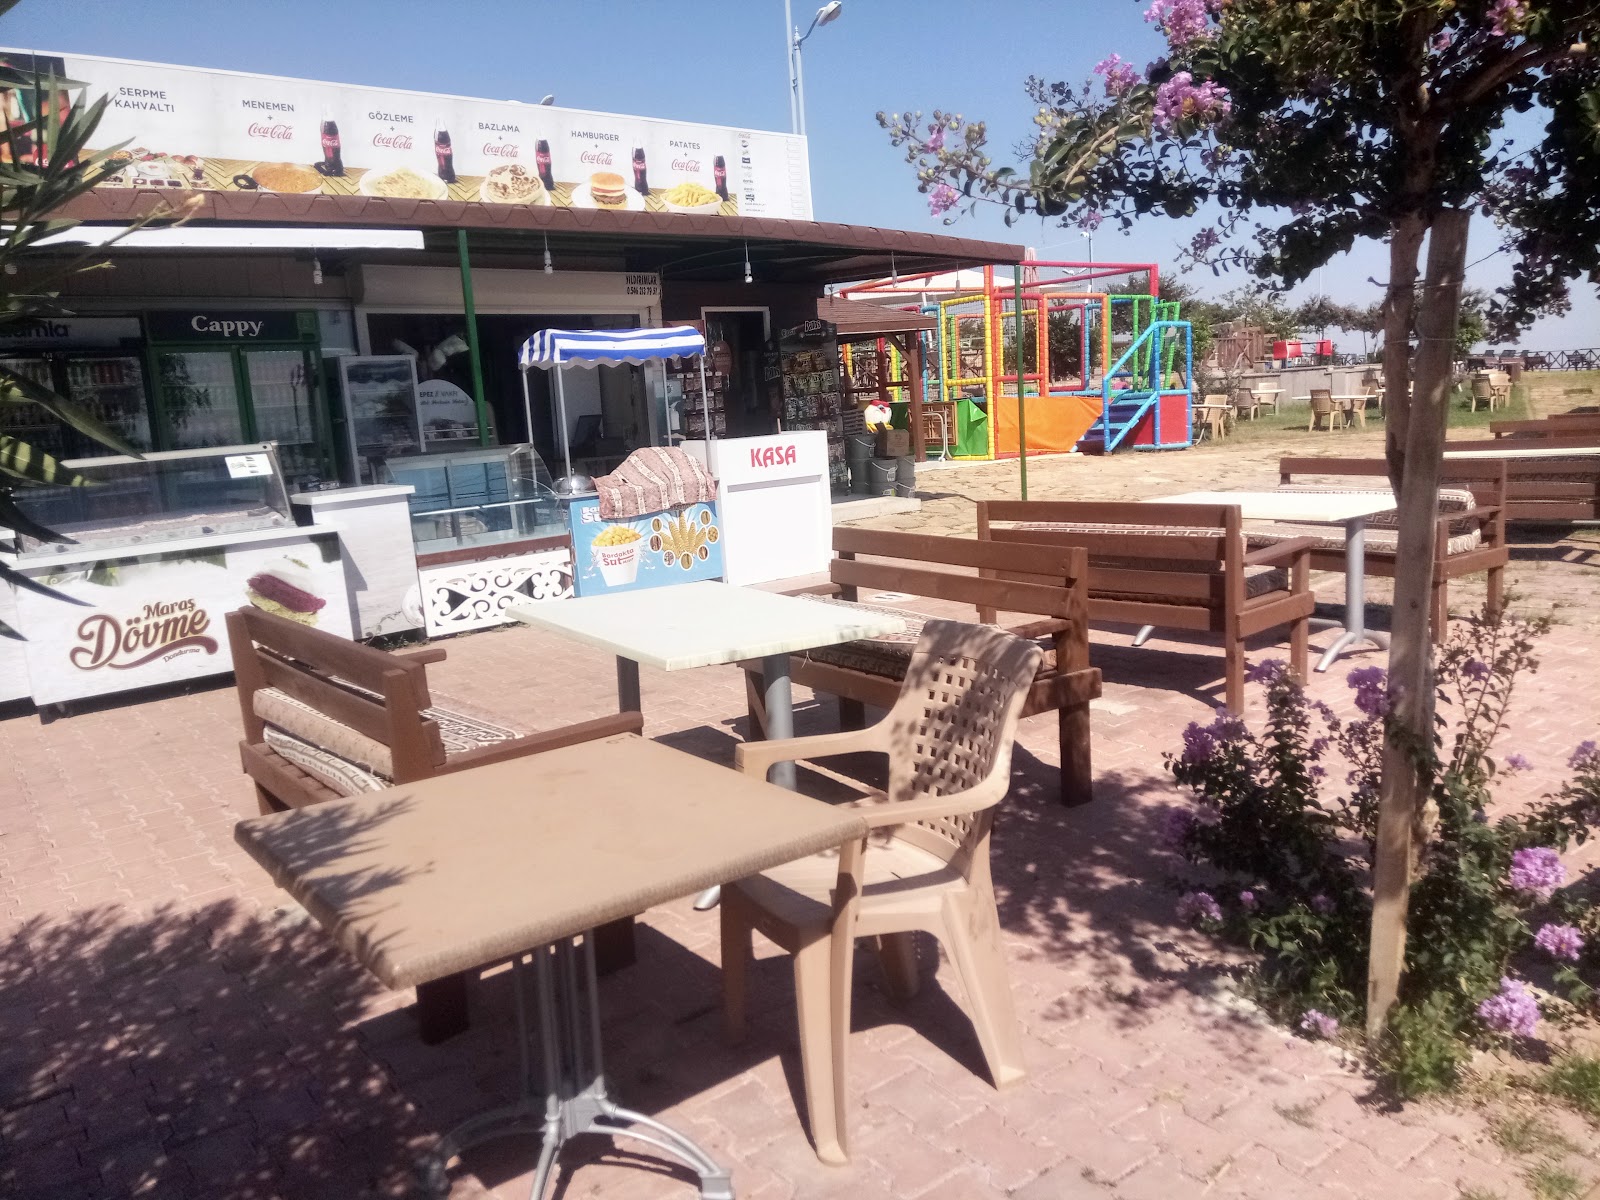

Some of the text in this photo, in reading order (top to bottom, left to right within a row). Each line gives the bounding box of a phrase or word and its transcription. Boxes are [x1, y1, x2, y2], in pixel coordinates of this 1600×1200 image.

[119, 87, 167, 100] SERPME
[114, 98, 175, 113] KAHVALTI
[242, 99, 295, 112] MENEMEN
[368, 112, 414, 123] GÖZLEME
[478, 122, 520, 133] BAZLAMA
[571, 130, 620, 142] HAMBURGER
[669, 140, 701, 150] PATATES
[191, 315, 263, 337] Cappy
[750, 444, 797, 468] KASA
[601, 548, 634, 560] Bardakta
[143, 598, 195, 619] Maraş
[70, 609, 211, 671] Dövme
[163, 648, 201, 662] Dondurma
